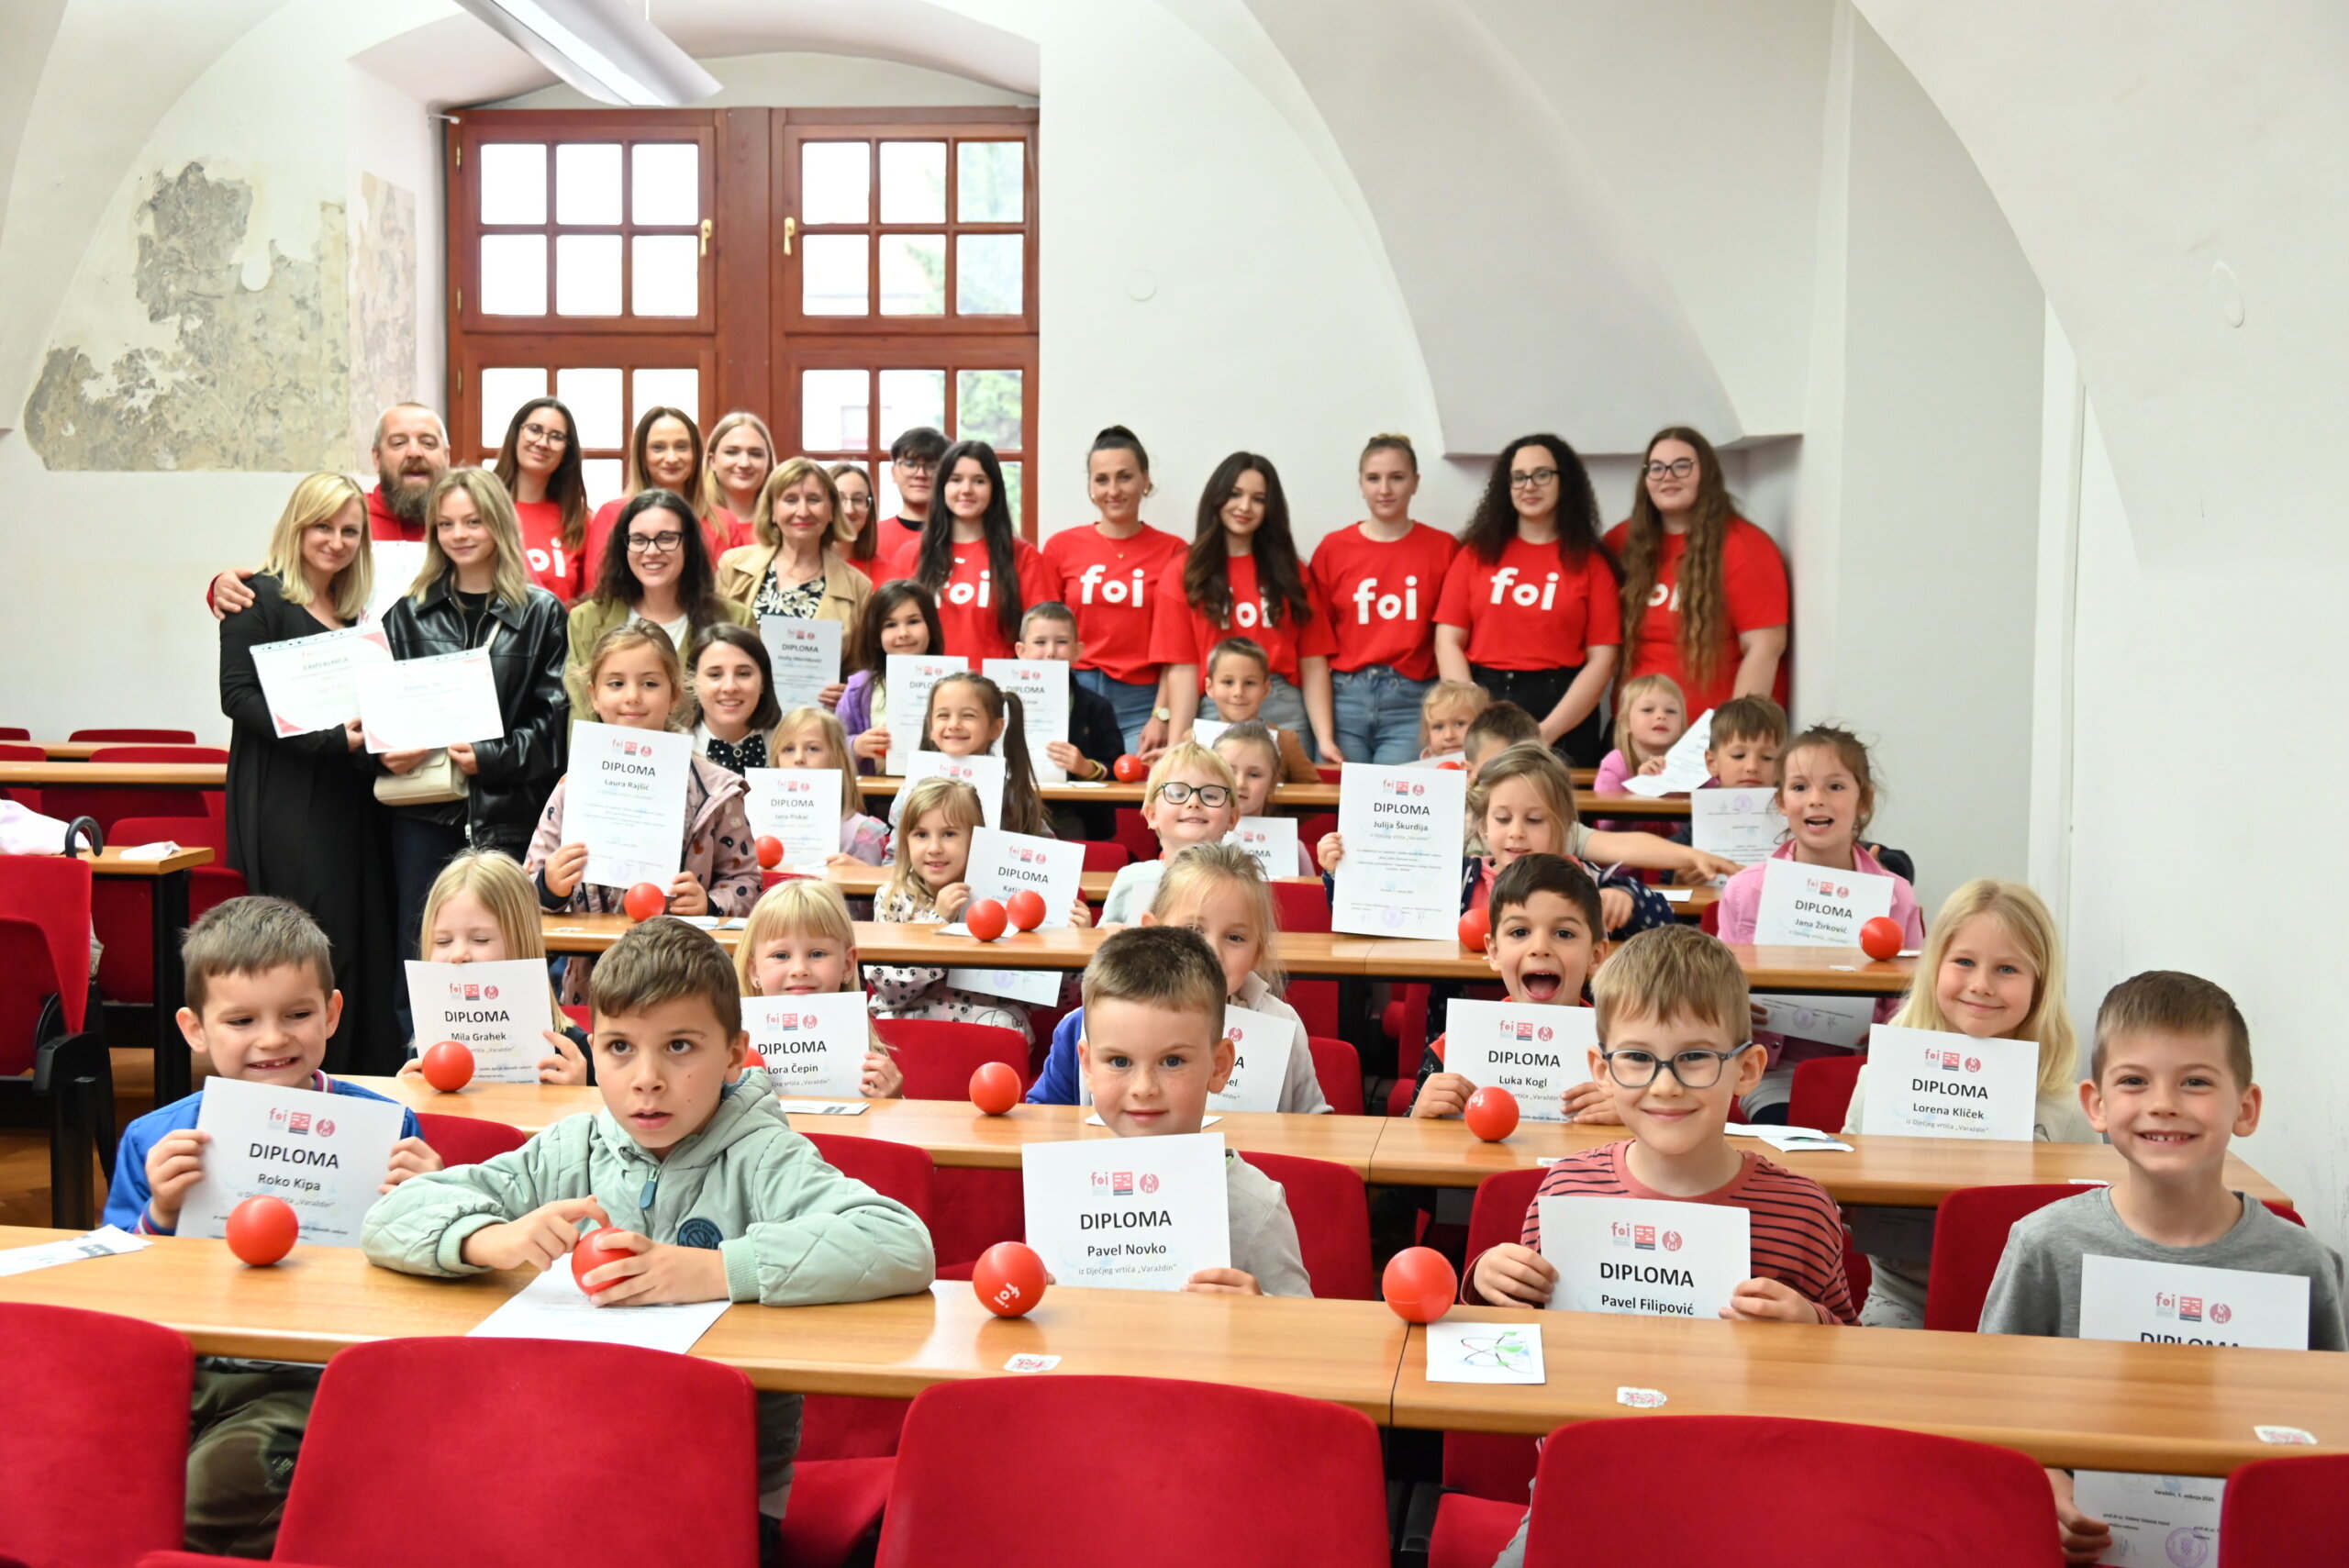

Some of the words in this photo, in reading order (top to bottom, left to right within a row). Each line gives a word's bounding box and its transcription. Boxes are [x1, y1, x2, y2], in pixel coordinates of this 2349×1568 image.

[526, 538, 567, 578] oi
[1080, 564, 1145, 608] foi
[1489, 566, 1560, 611] foi
[1353, 575, 1419, 625] foi
[1647, 581, 1681, 611] oi
[1220, 586, 1274, 629] oi
[782, 643, 819, 653] DIPLOMA
[909, 681, 933, 689] DIPLO
[1006, 685, 1045, 695] DIPLOMA
[602, 761, 656, 777] DIPLOMA
[605, 779, 626, 788] Laura
[771, 798, 814, 807] DIPLOMA
[1374, 802, 1431, 817] DIPLOMA
[1374, 821, 1394, 830] Julija
[1396, 820, 1429, 832] Škurdija
[997, 866, 1049, 884] DIPLOMA
[1795, 899, 1853, 919] DIPLOMA
[1796, 918, 1813, 928] Jana
[1815, 920, 1847, 934] Žirković
[445, 1010, 510, 1023] DIPLOMA
[765, 1013, 780, 1024] foi
[1499, 1020, 1514, 1031] foi
[451, 1032, 470, 1041] Mila
[472, 1032, 507, 1041] Grahek
[758, 1040, 828, 1055] DIPLOMA
[1925, 1049, 1940, 1061] foi
[1488, 1050, 1561, 1067] DIPLOMA
[768, 1065, 788, 1074] Lora
[791, 1062, 818, 1074] Čepin
[1498, 1075, 1522, 1086] Luka
[1525, 1077, 1547, 1089] Kogl
[1912, 1078, 1988, 1099] DIPLOMA
[269, 1107, 288, 1123] foi
[1913, 1103, 1949, 1116] Lorena
[1953, 1107, 1984, 1119] Kliček
[249, 1143, 340, 1169] DIPLOMA
[258, 1173, 290, 1187] Roko
[293, 1178, 321, 1192] Kipa
[1091, 1171, 1109, 1186] foi
[1080, 1210, 1173, 1230] DIPLOMA
[1611, 1221, 1631, 1238] foi
[1087, 1243, 1121, 1257] Pavel
[1126, 1242, 1167, 1256] Novko
[1086, 1265, 1113, 1276] Dječjeg
[1115, 1264, 1136, 1273] vrtića
[1600, 1262, 1695, 1288] DIPLOMA
[994, 1282, 1022, 1309] foi
[2155, 1292, 2176, 1308] foi
[1601, 1295, 1636, 1309] Pavel
[1640, 1297, 1694, 1316] Filipović
